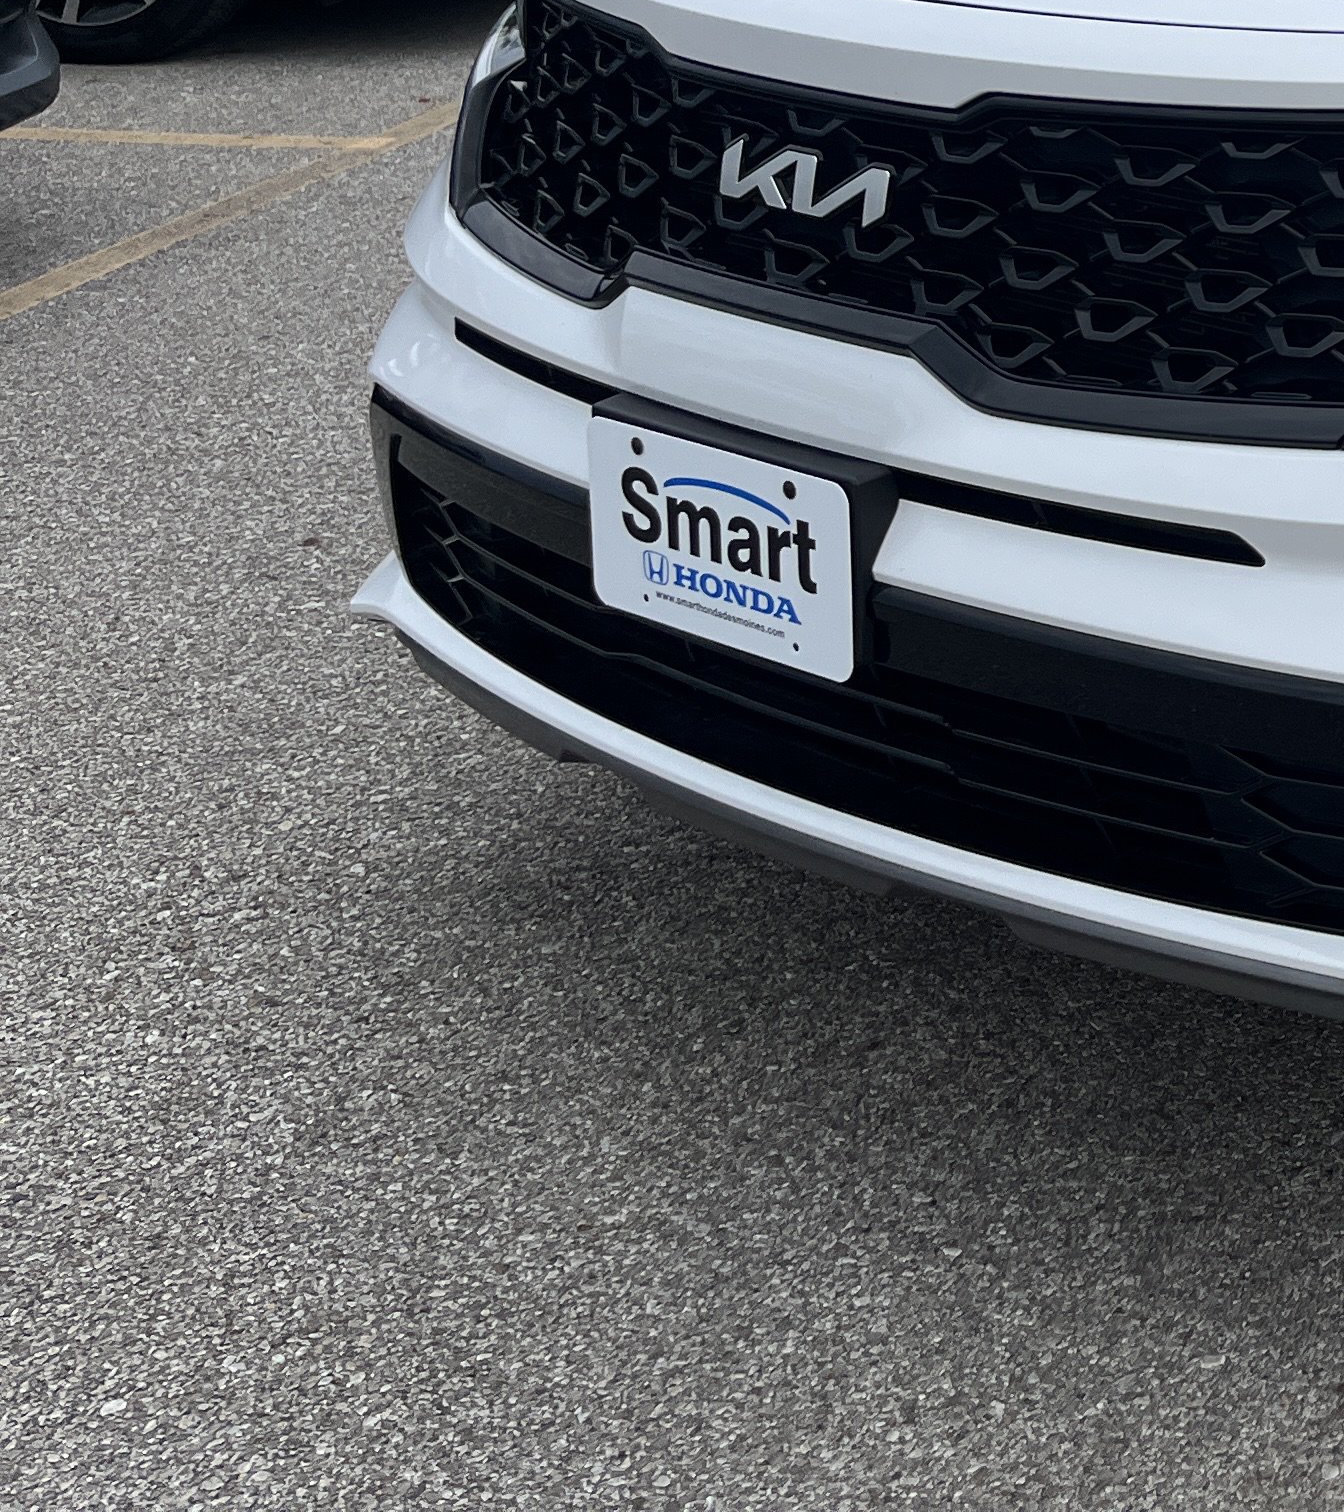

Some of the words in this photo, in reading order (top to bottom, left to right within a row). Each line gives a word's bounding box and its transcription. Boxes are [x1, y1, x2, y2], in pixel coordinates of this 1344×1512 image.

[719, 138, 891, 228] KIA
[620, 465, 818, 595] Smart
[673, 563, 803, 626] HONDA
